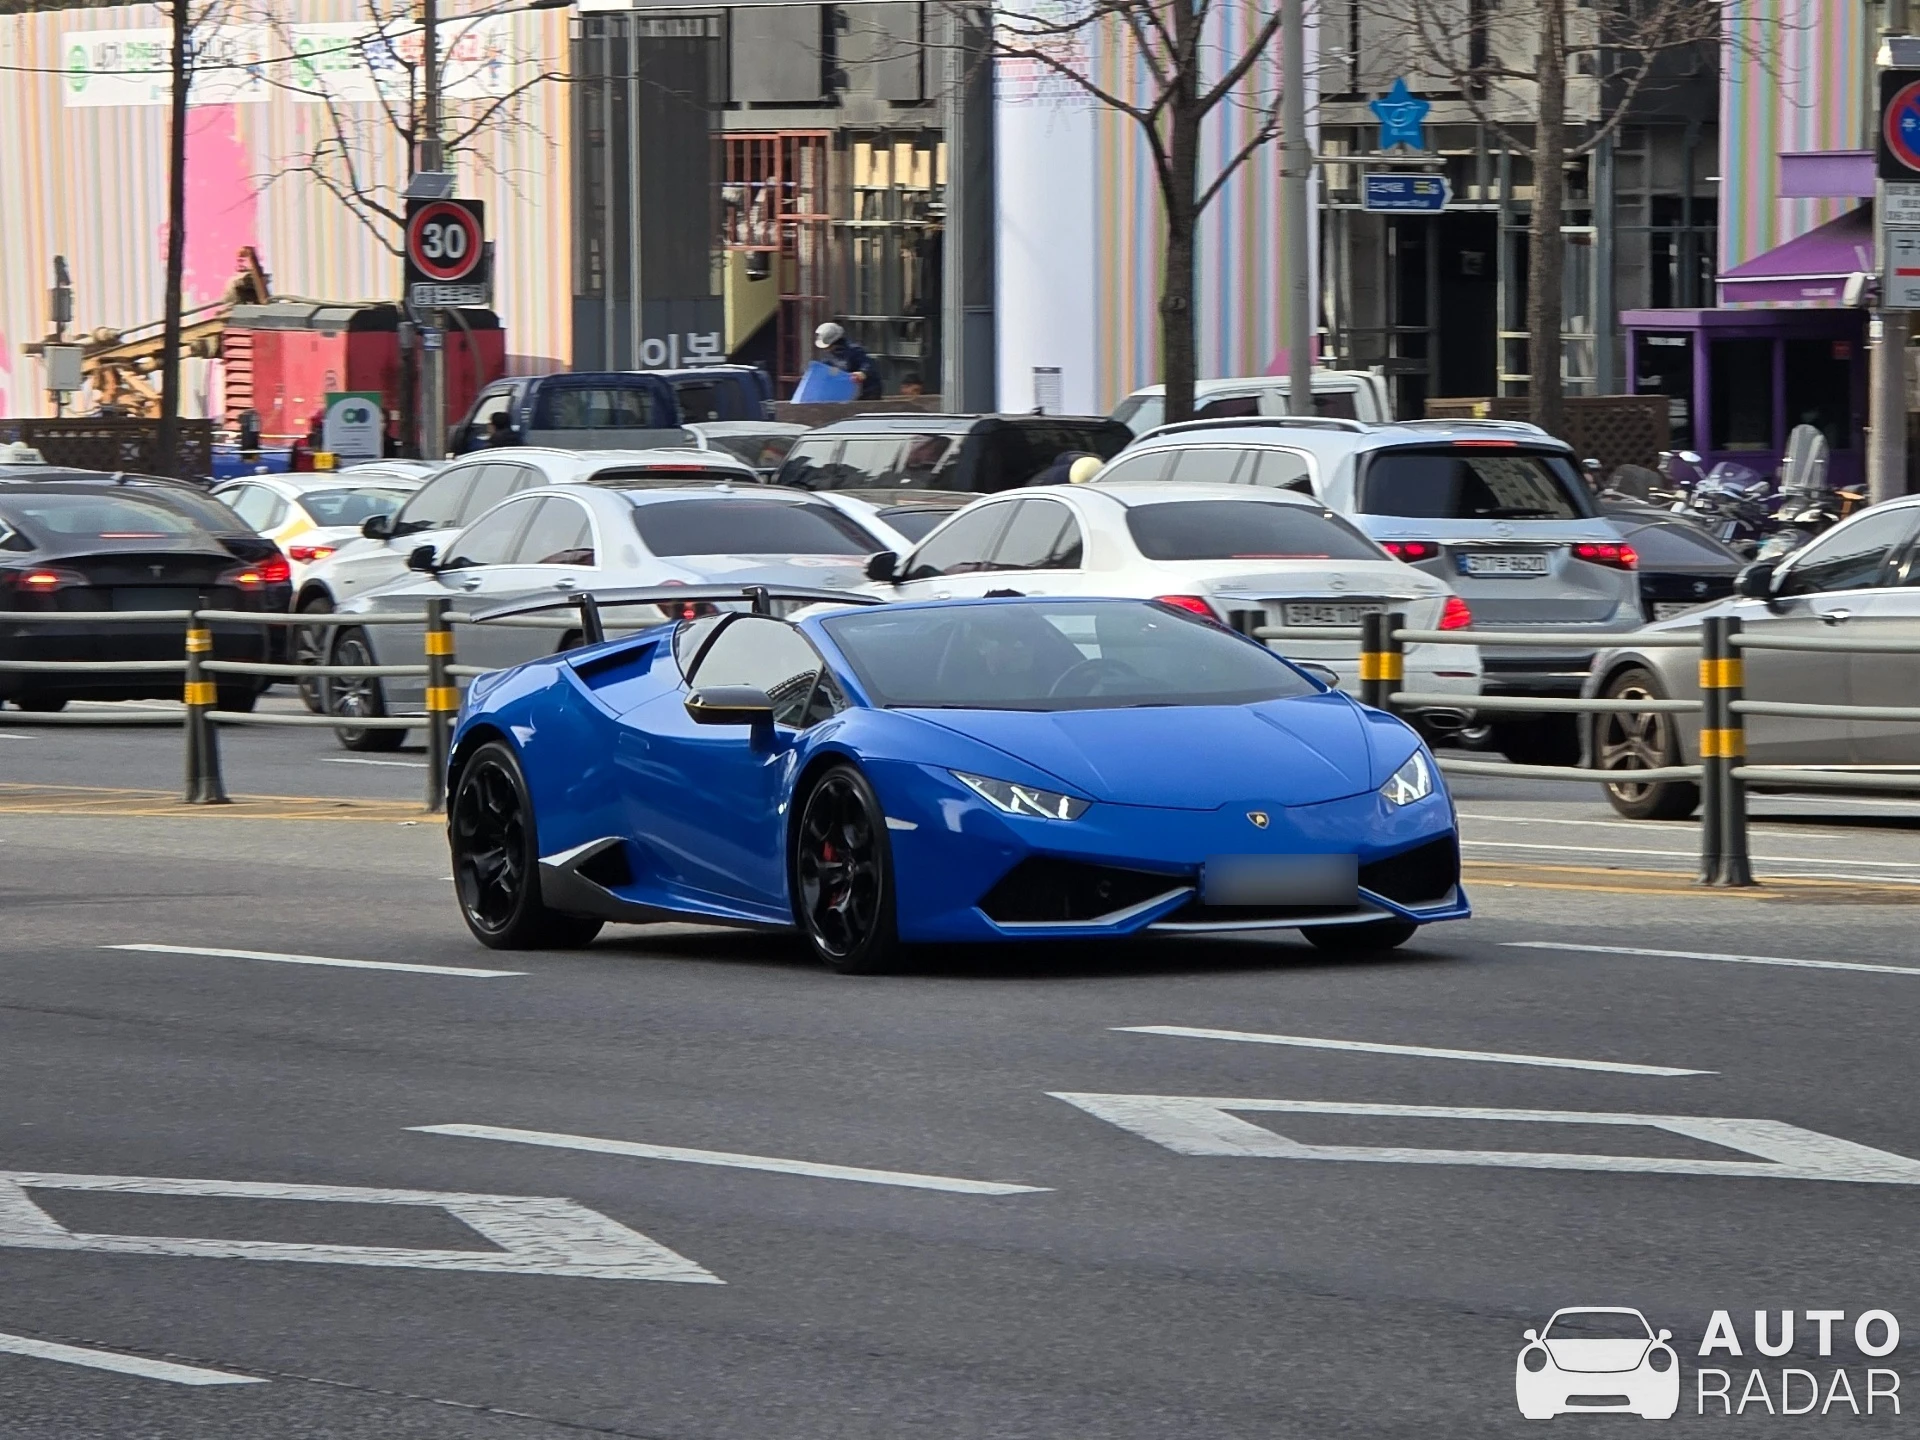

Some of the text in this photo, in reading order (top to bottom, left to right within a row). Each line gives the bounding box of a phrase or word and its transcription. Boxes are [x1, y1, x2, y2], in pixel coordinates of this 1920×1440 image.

[1902, 117, 1920, 133] 주
[421, 223, 467, 259] 30
[1895, 239, 1920, 256] 구
